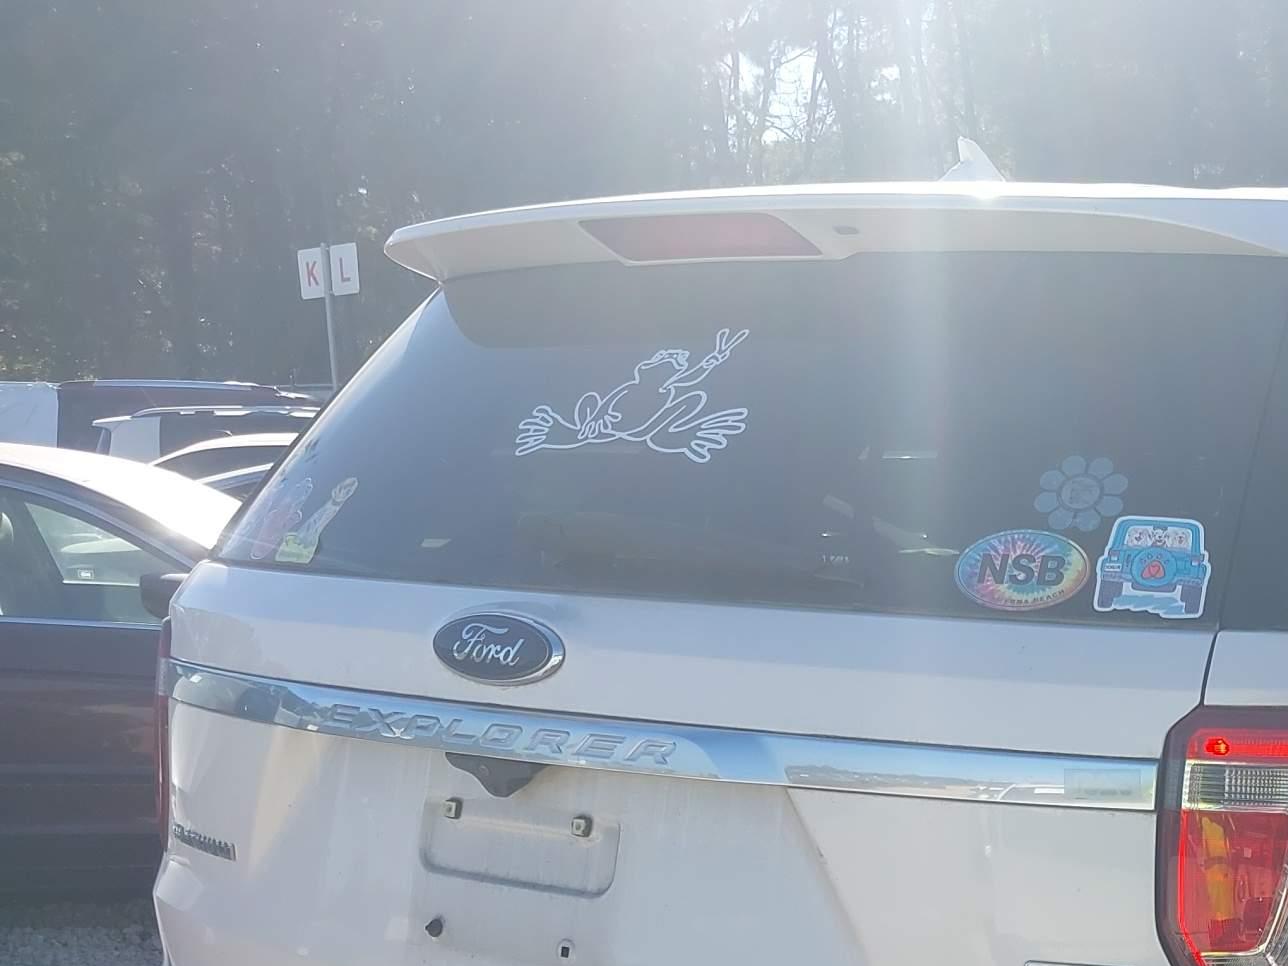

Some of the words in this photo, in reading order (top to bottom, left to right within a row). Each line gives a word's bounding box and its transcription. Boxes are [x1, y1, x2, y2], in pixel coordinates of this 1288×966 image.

[306, 261, 319, 287] K
[339, 257, 351, 282] L
[976, 552, 1066, 587] NSB
[453, 623, 525, 666] Ford
[329, 703, 677, 766] EXPLORER
